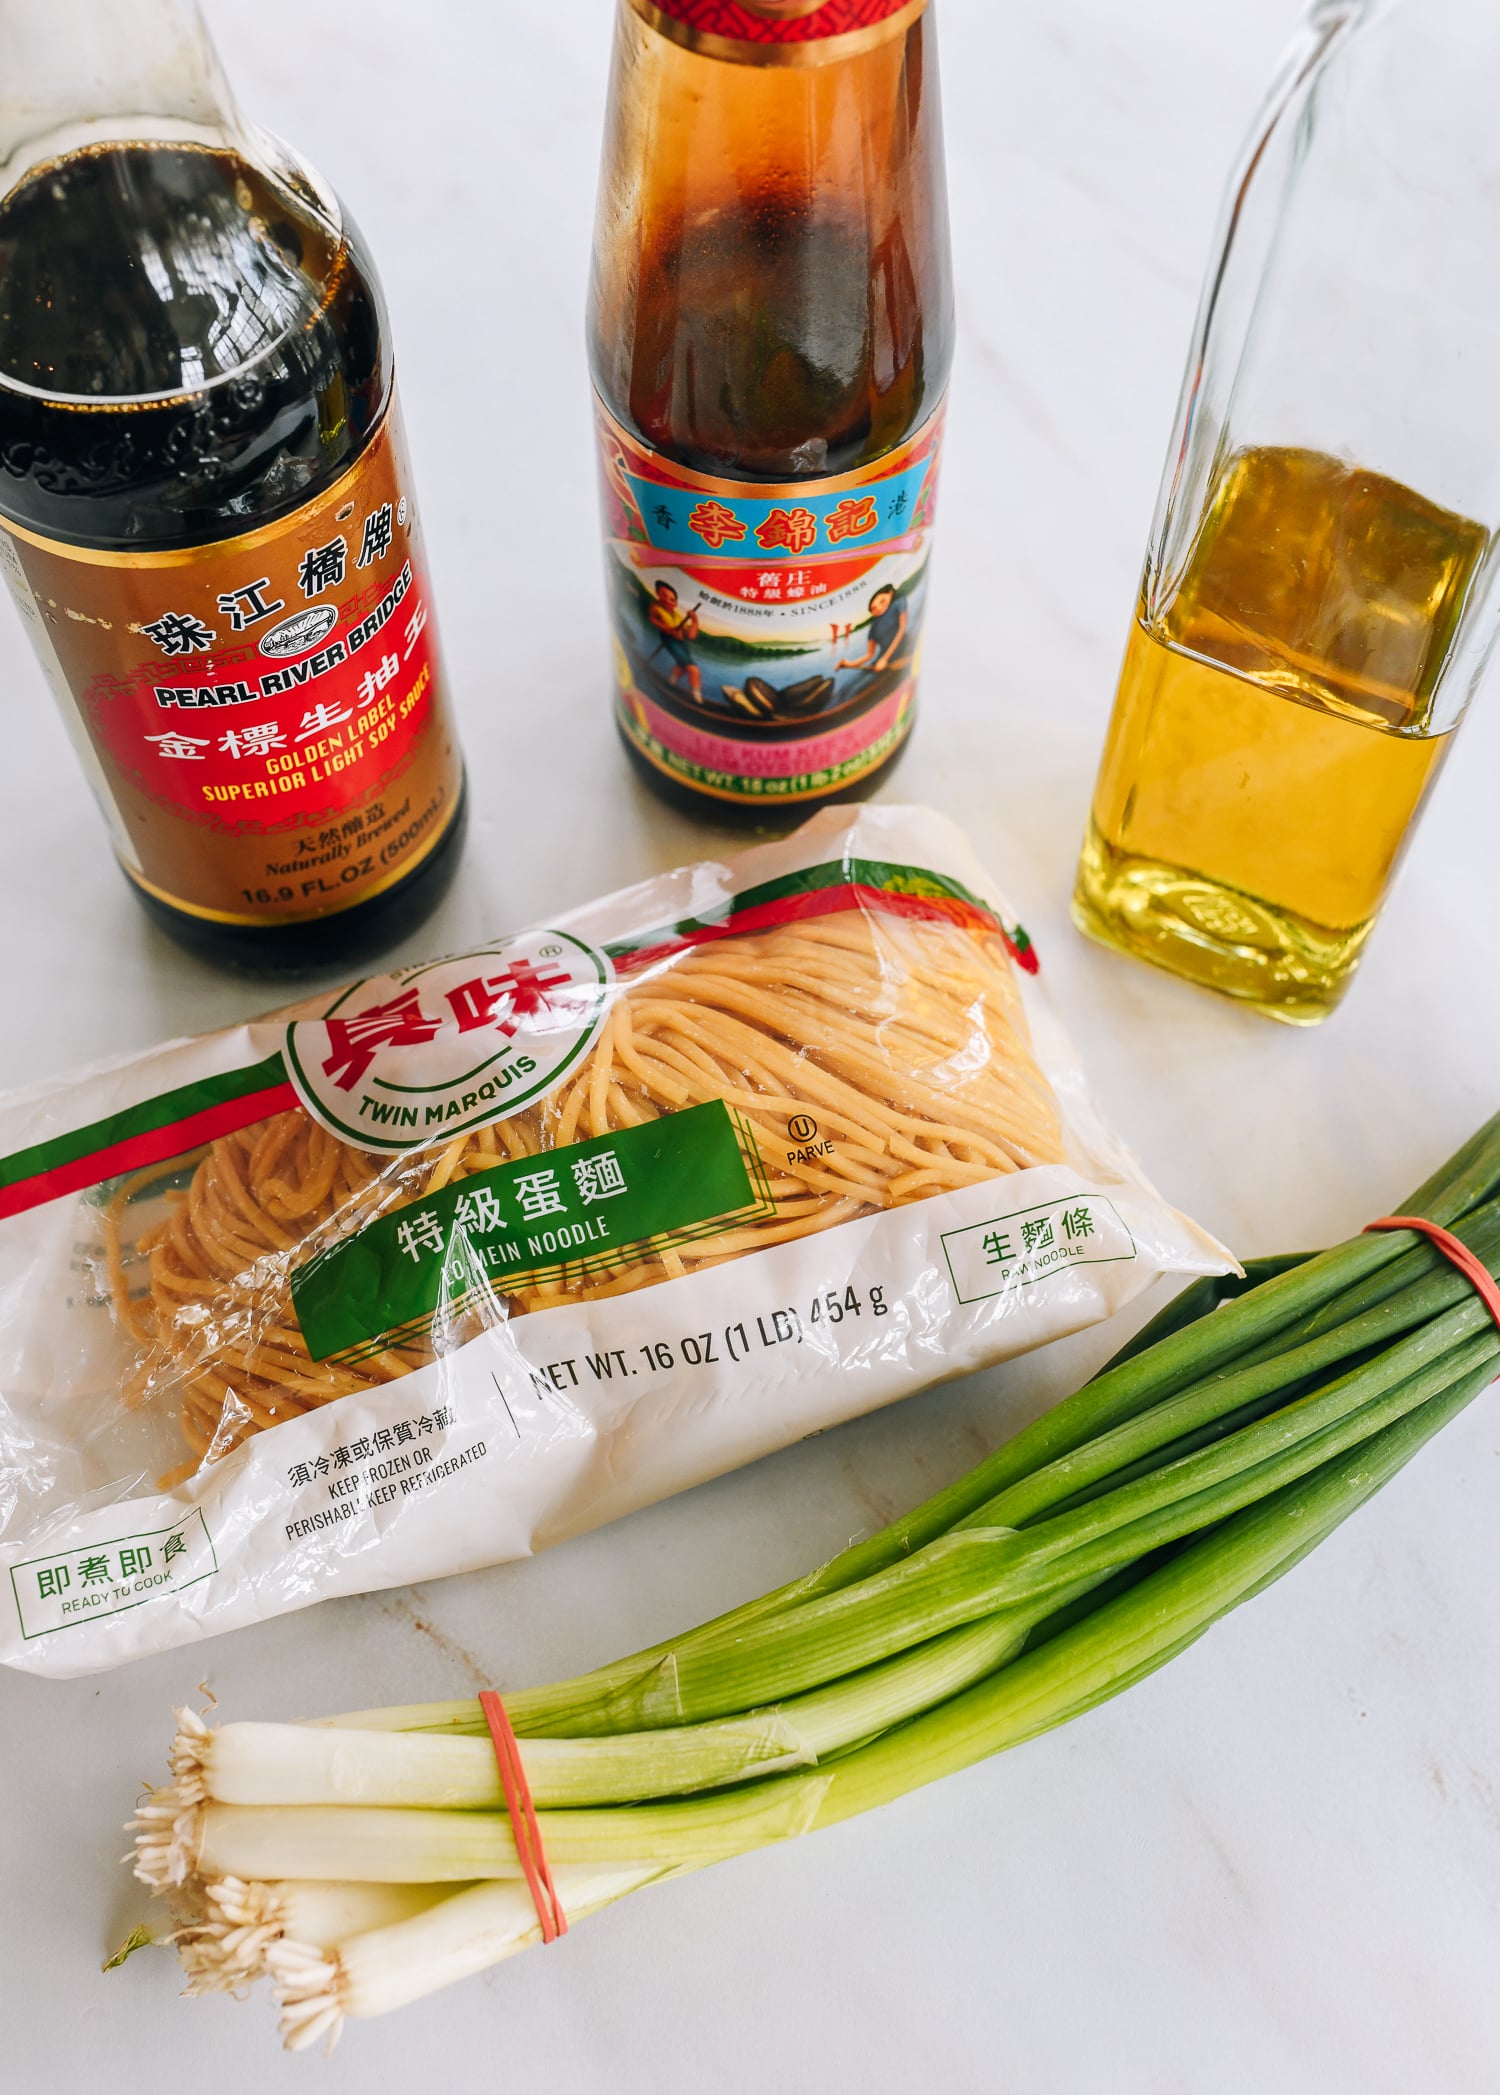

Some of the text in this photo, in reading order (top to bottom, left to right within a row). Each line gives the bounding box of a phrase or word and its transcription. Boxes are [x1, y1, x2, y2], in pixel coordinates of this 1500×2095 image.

[689, 496, 879, 554] 李錦記
[144, 503, 393, 654] 珠江橋牌
[154, 560, 413, 709] PEARL RIVER BRIDGE
[143, 599, 428, 760] 金標生抽王
[201, 661, 431, 802] SUPERIOR LIGHT SOY SAUCE
[265, 693, 396, 775] GOLDEN LABEL
[266, 797, 411, 877] Naturally Brewed
[242, 886, 295, 905] 16.9
[301, 856, 375, 897] FL.OZ
[358, 1055, 537, 1127] TWIN MARQUIS
[786, 1139, 835, 1166] PARVE
[397, 1150, 628, 1263] 特級蛋麵
[527, 1214, 611, 1257] NOODLE
[982, 1207, 1096, 1265] 生麵條
[1034, 1245, 1085, 1270] NOODLE
[529, 1359, 579, 1400] NET
[585, 1350, 638, 1380] WT.
[639, 1342, 675, 1373] 16
[680, 1331, 720, 1366] OZ
[724, 1322, 750, 1362] (1
[811, 1285, 862, 1326] 454
[869, 1285, 889, 1316] g
[328, 1475, 360, 1500] KEEP
[413, 1447, 433, 1466] OR
[367, 1484, 397, 1508] KEEP
[400, 1441, 487, 1495] REFRIGERATED
[36, 1531, 187, 1600] 即煮即食
[61, 1570, 174, 1615] READY TO COOK
